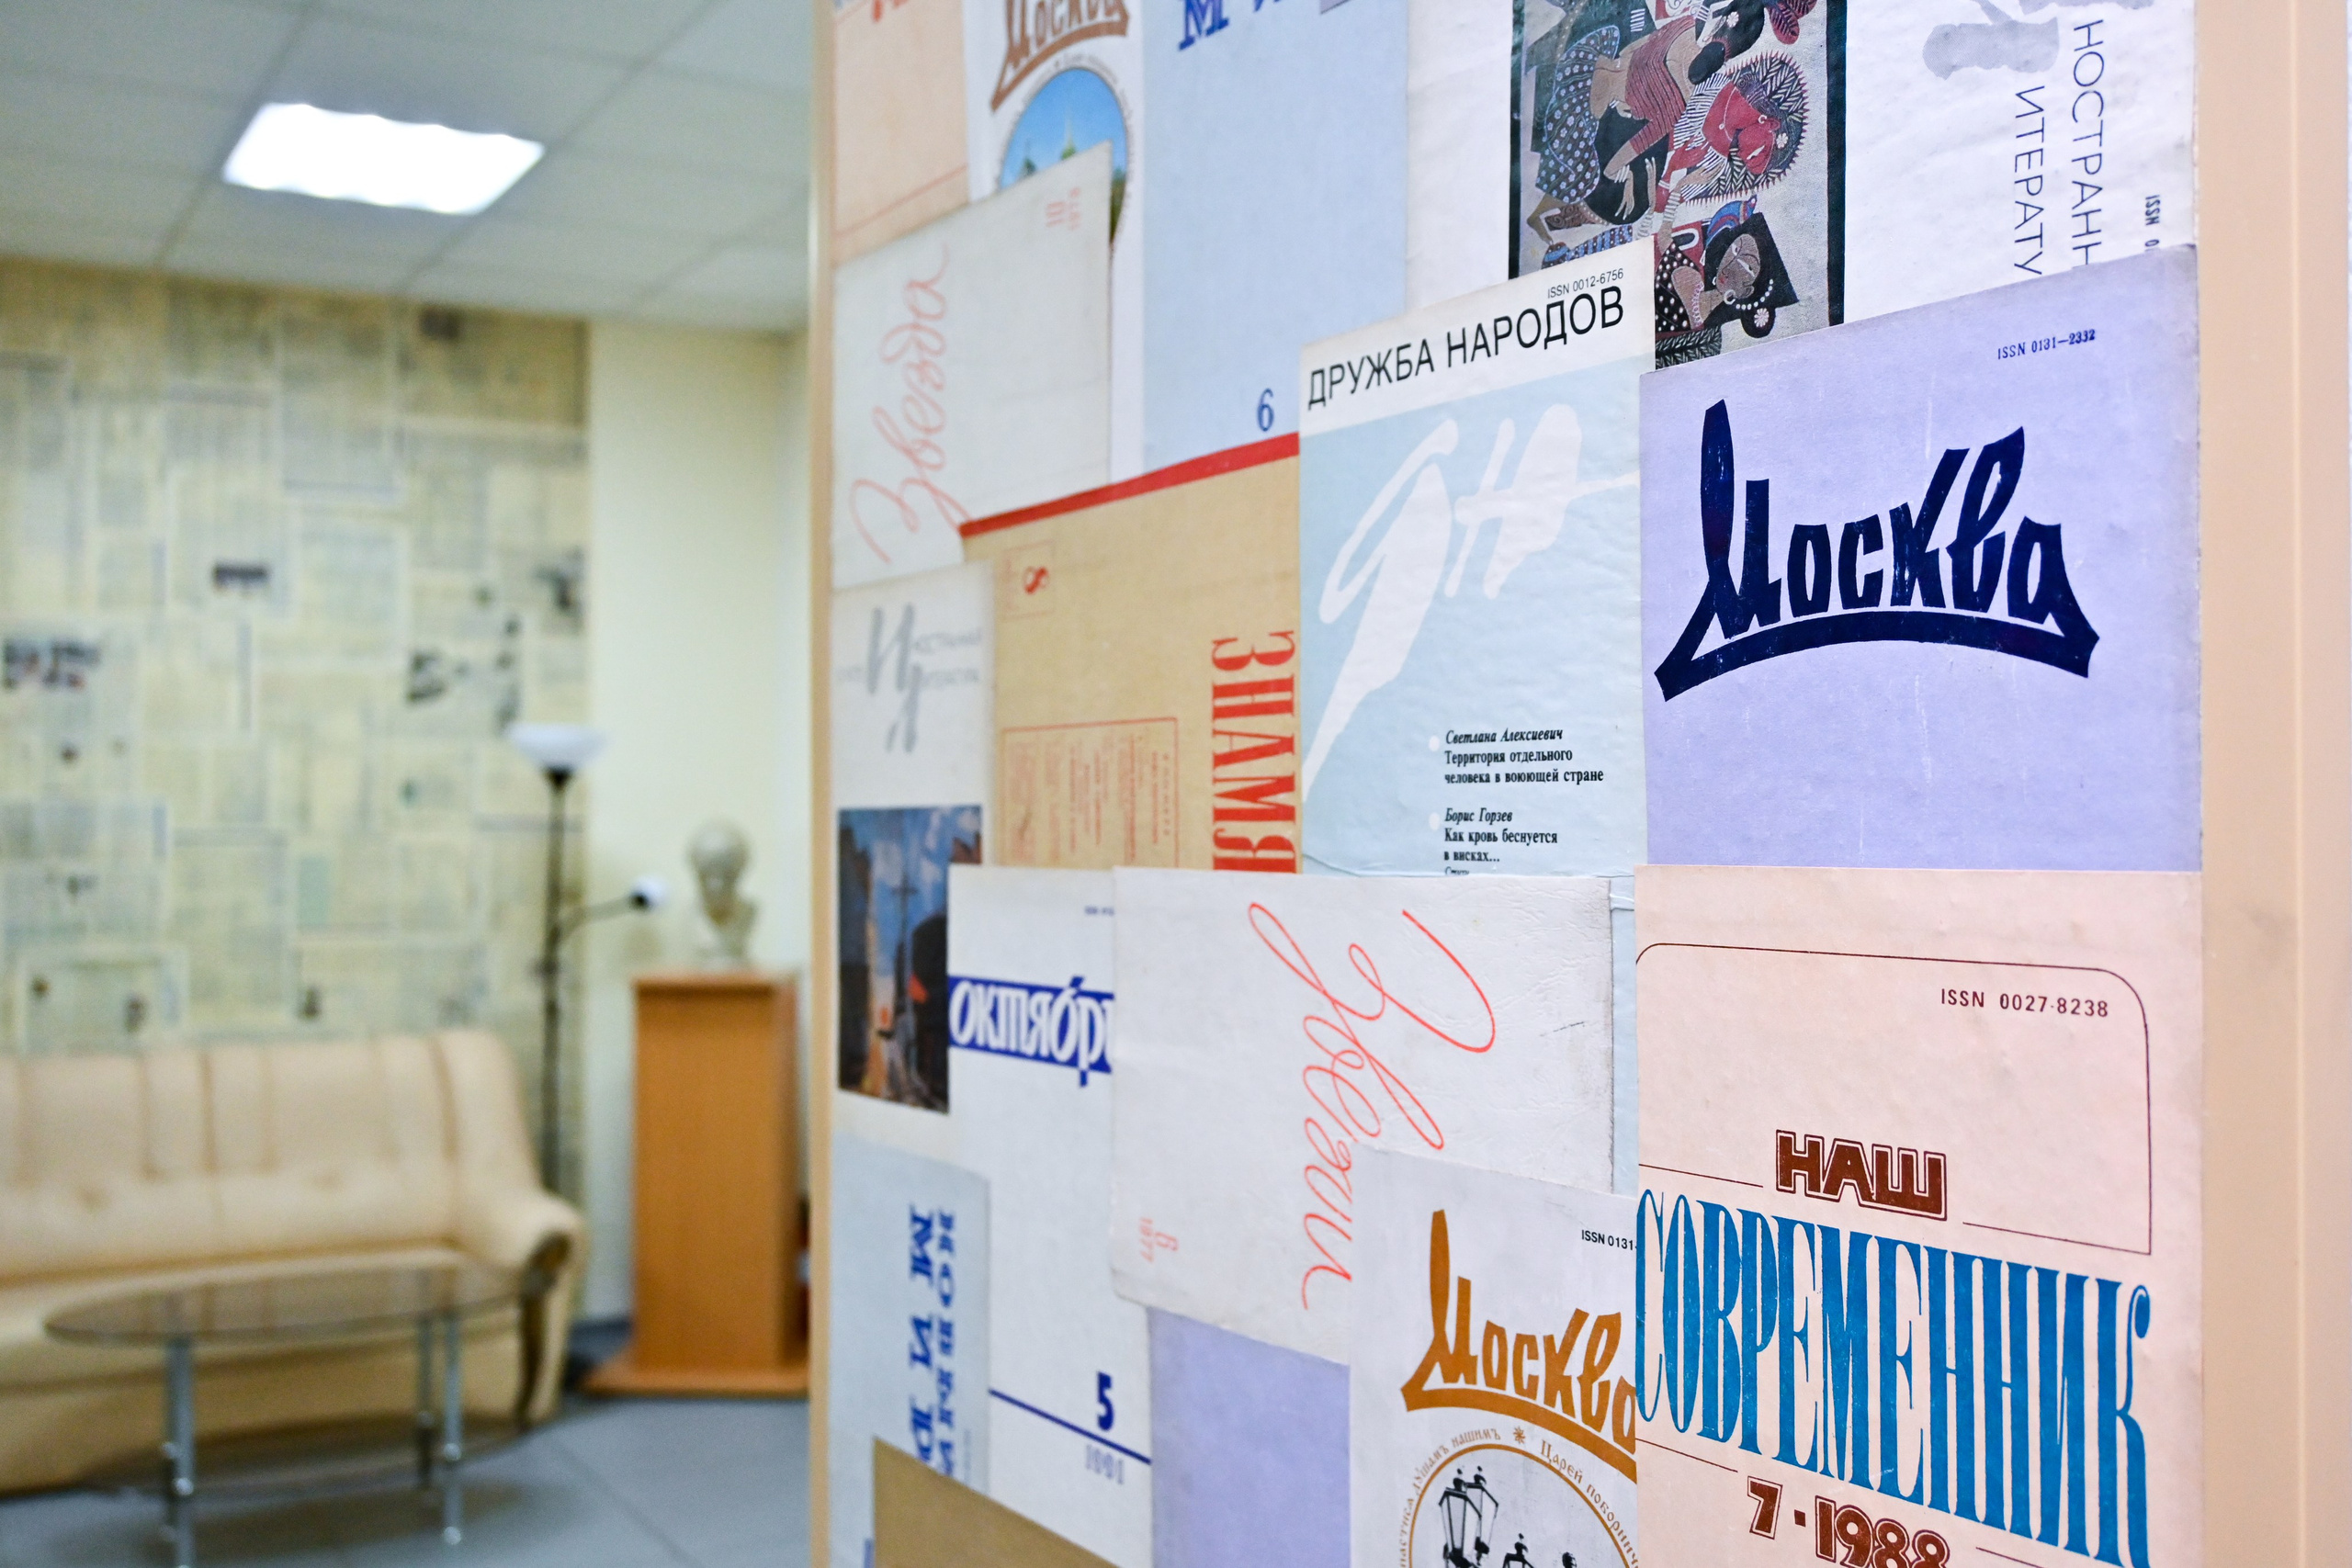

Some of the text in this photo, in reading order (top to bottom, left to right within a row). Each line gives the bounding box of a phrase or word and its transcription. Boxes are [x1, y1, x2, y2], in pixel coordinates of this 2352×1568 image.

[2145, 194, 2160, 225] ISSN
[1547, 267, 1624, 299] ISSN 0012-6756
[1308, 285, 1624, 411] ДРУЖБА НАРОДОВ
[1997, 342, 2026, 360] ISSN
[1257, 388, 1274, 432] 6
[1654, 399, 2100, 702] Москва
[1445, 728, 1564, 745] Светлана Алексиевич
[1211, 630, 1297, 874] ЗНАМЯ
[1444, 749, 1573, 768] Территория отдельного
[1444, 769, 1604, 785] человека в воюющей стране
[1444, 807, 1513, 825] Борис Горзев
[1444, 828, 1558, 846] Как кровь беснуется
[1443, 851, 1500, 863] в висках...
[1941, 987, 1984, 1009] ISSN
[1776, 1129, 1948, 1222] НАШ
[1581, 1229, 1605, 1245] ISSN
[1635, 1189, 2153, 1568] СОВРЕМЕННИК
[1097, 1370, 1114, 1432] 5
